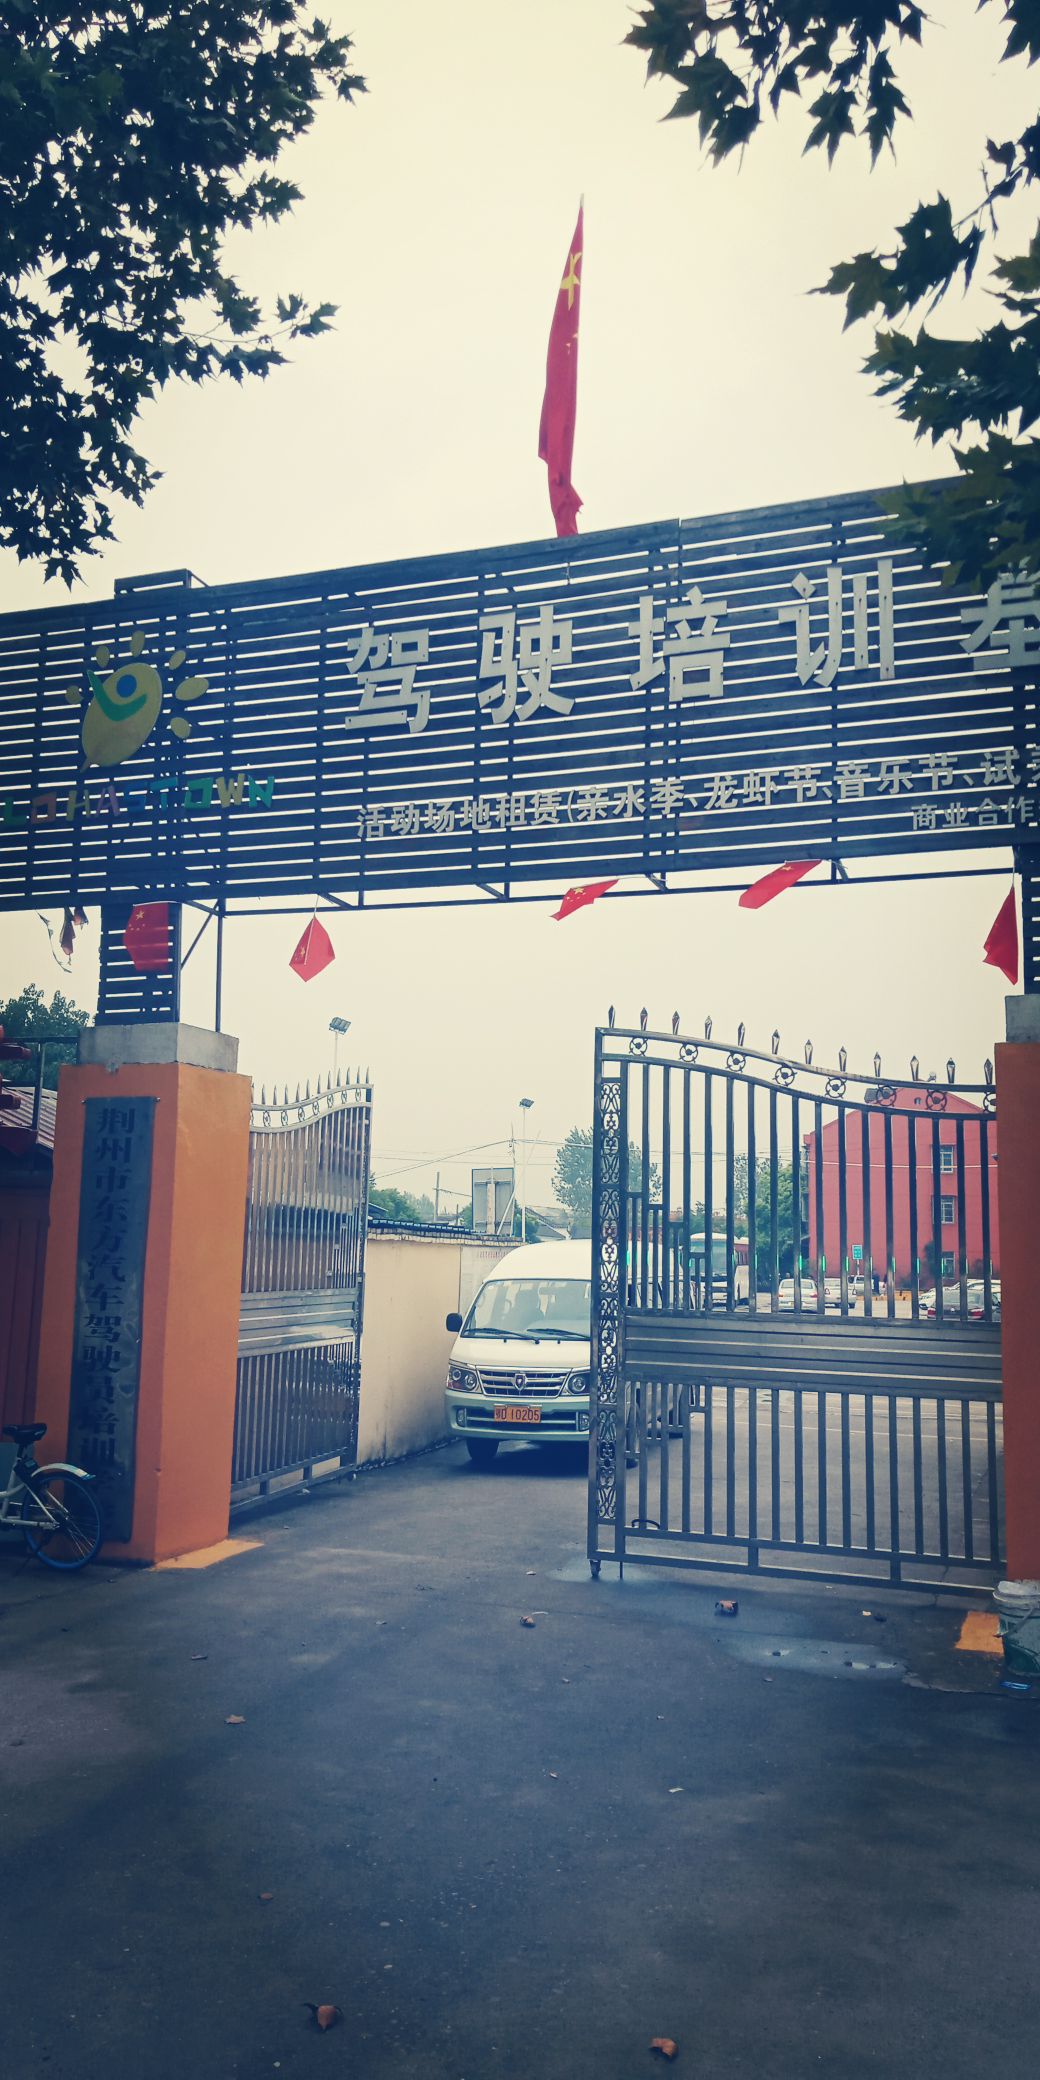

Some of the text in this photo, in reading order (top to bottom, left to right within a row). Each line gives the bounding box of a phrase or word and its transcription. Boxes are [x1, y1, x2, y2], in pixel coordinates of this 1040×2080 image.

[78, 1107, 136, 1530] 荆州市东方汽车驾驶员培训
[511, 1409, 540, 1421] 10205
